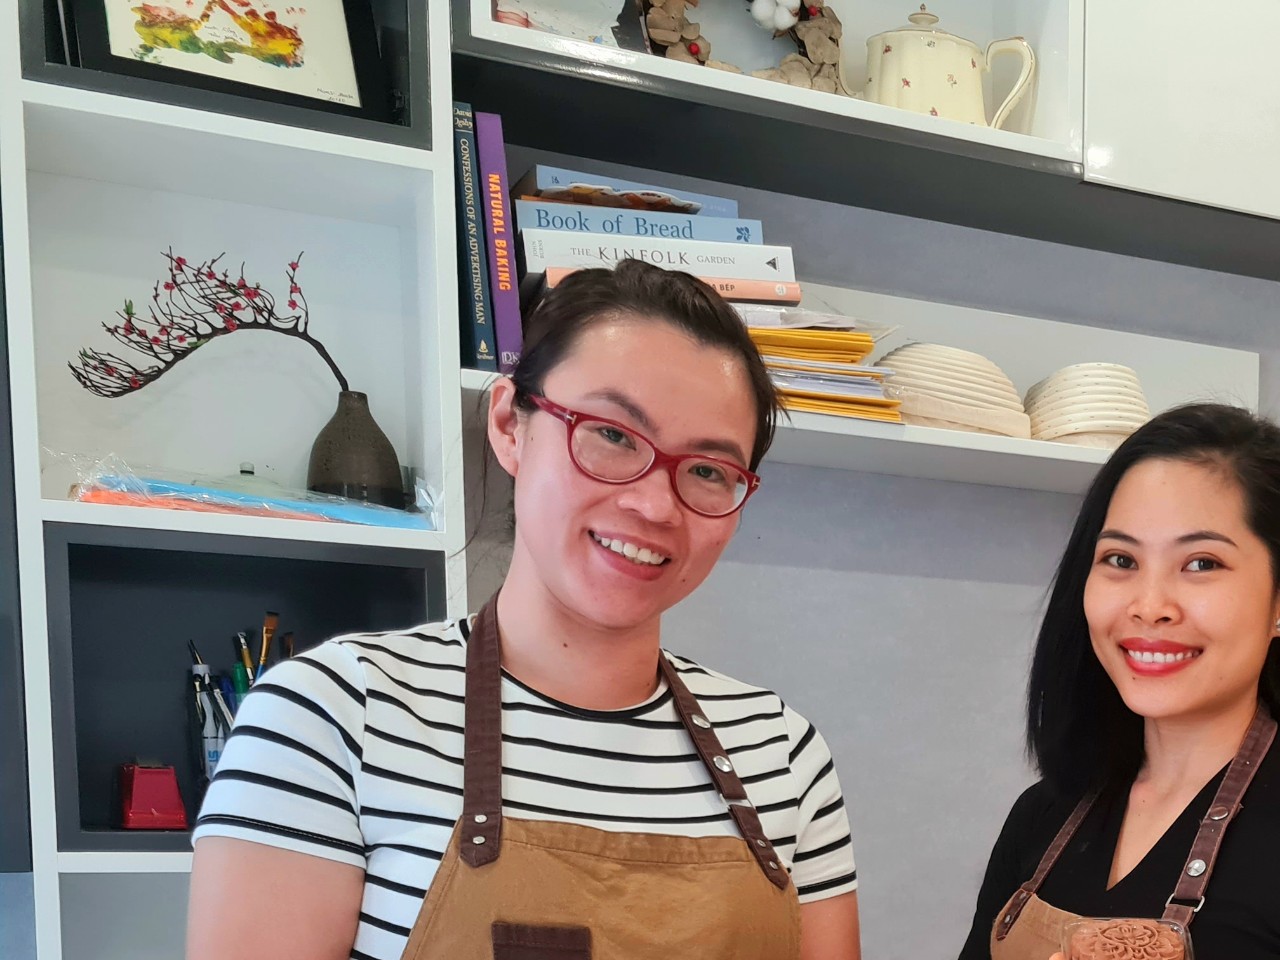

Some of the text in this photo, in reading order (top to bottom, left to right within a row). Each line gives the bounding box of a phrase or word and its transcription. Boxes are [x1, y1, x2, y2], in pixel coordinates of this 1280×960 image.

[460, 138, 486, 325] CONFESSIONS OF AN ADVERTISING MAN
[488, 173, 512, 291] NATURAL BAKING
[535, 208, 695, 240] Book of Bread
[569, 246, 736, 265] THE KINFOLK GARDEN
